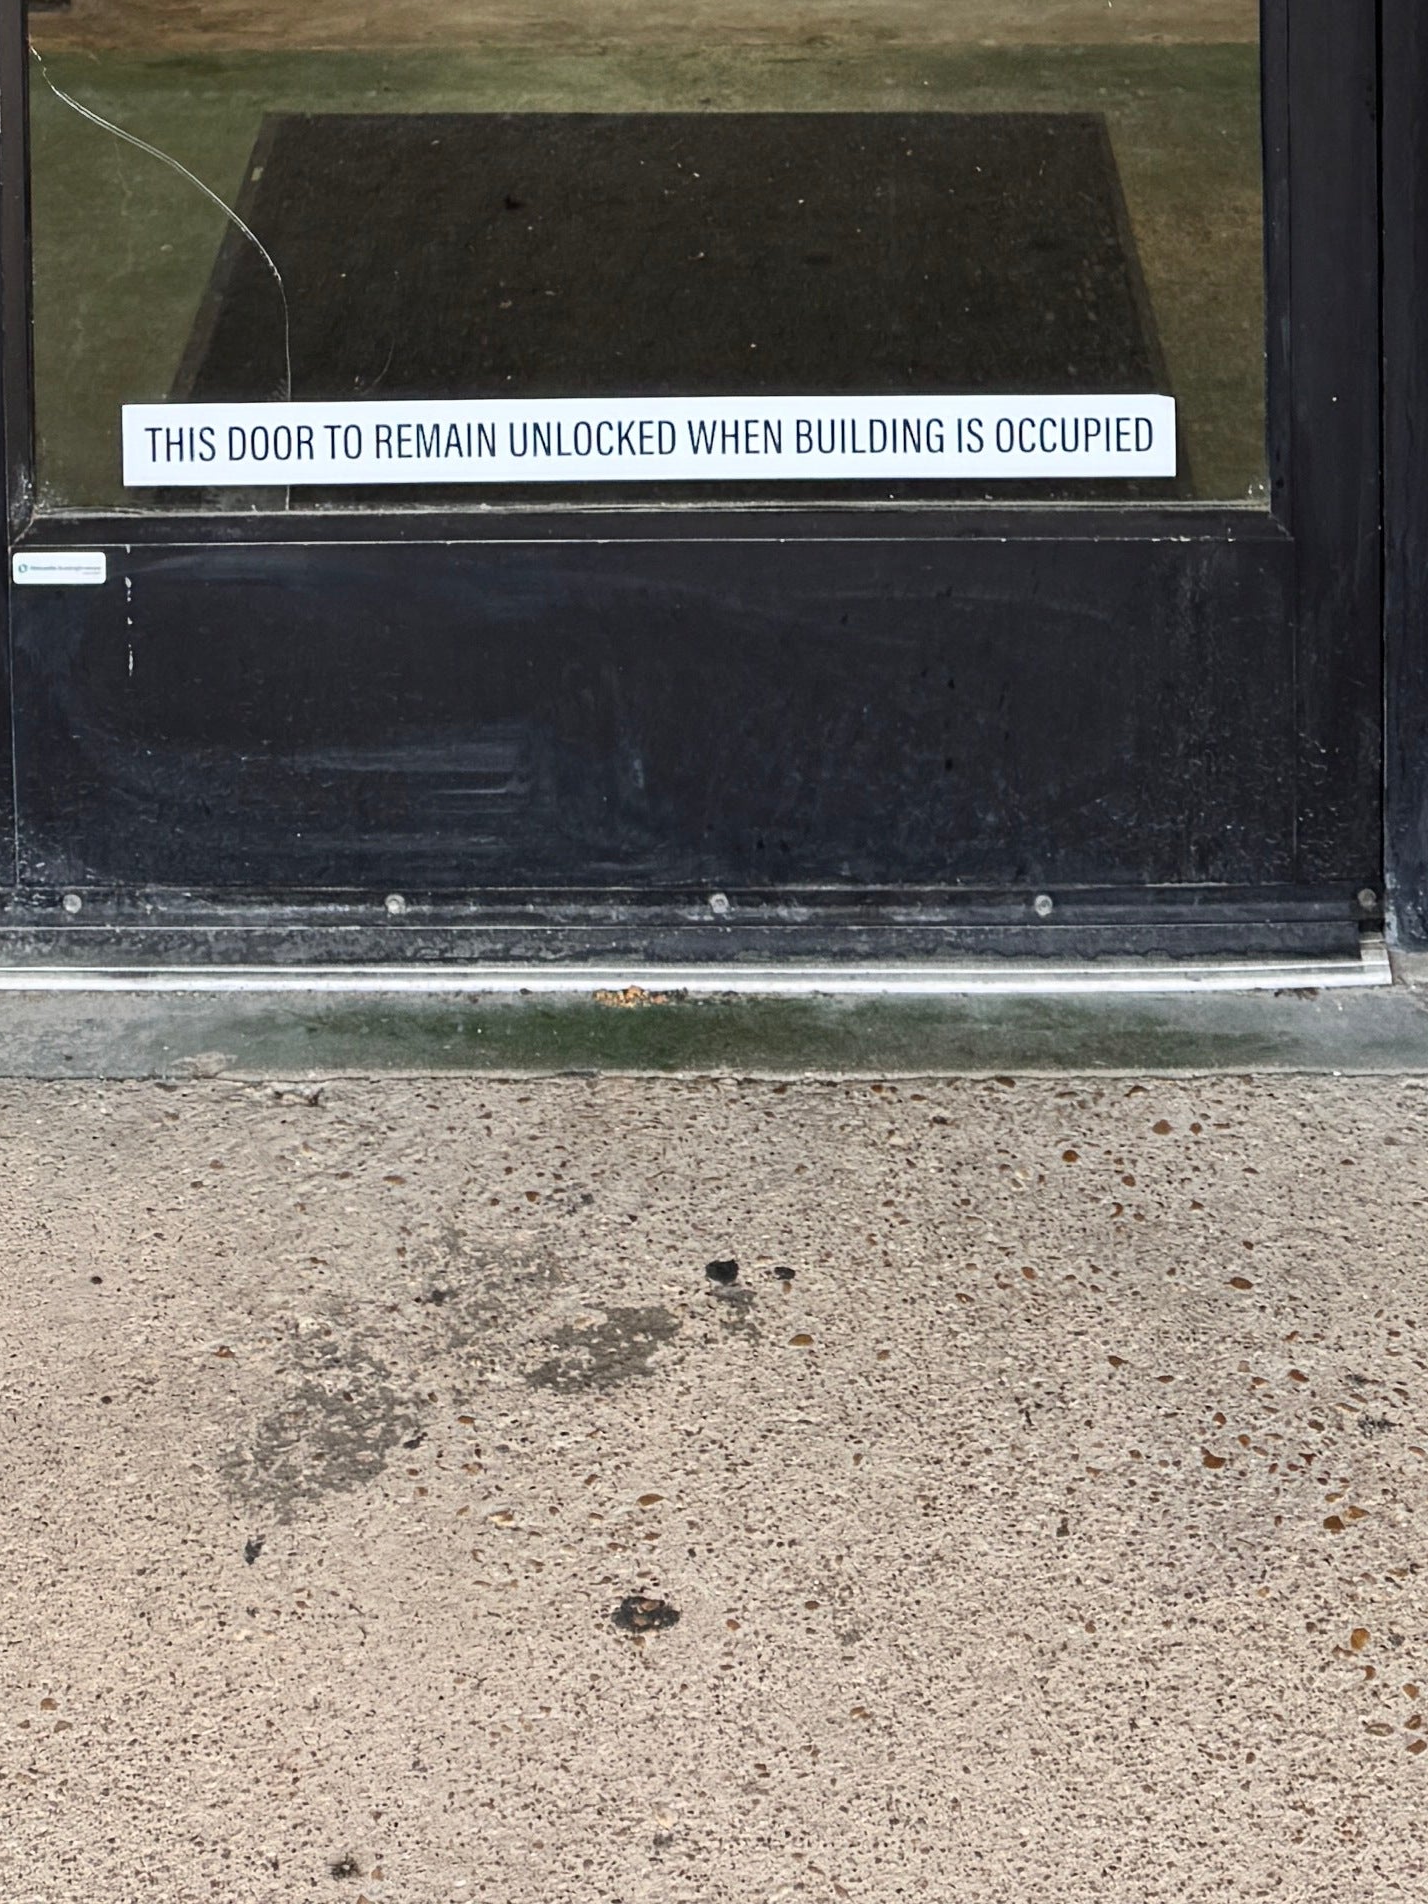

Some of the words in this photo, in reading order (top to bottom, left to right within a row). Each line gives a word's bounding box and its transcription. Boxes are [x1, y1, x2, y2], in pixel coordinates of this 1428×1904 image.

[144, 426, 216, 463] THIS
[228, 425, 314, 461] DOOR
[323, 424, 362, 460] TO
[375, 422, 496, 459] REMAIN
[509, 420, 676, 457] UNLOCKED
[687, 419, 782, 455] WHEN
[796, 418, 944, 454] BUILDING
[957, 417, 984, 454] IS
[995, 417, 1153, 453] OCCUPIED
